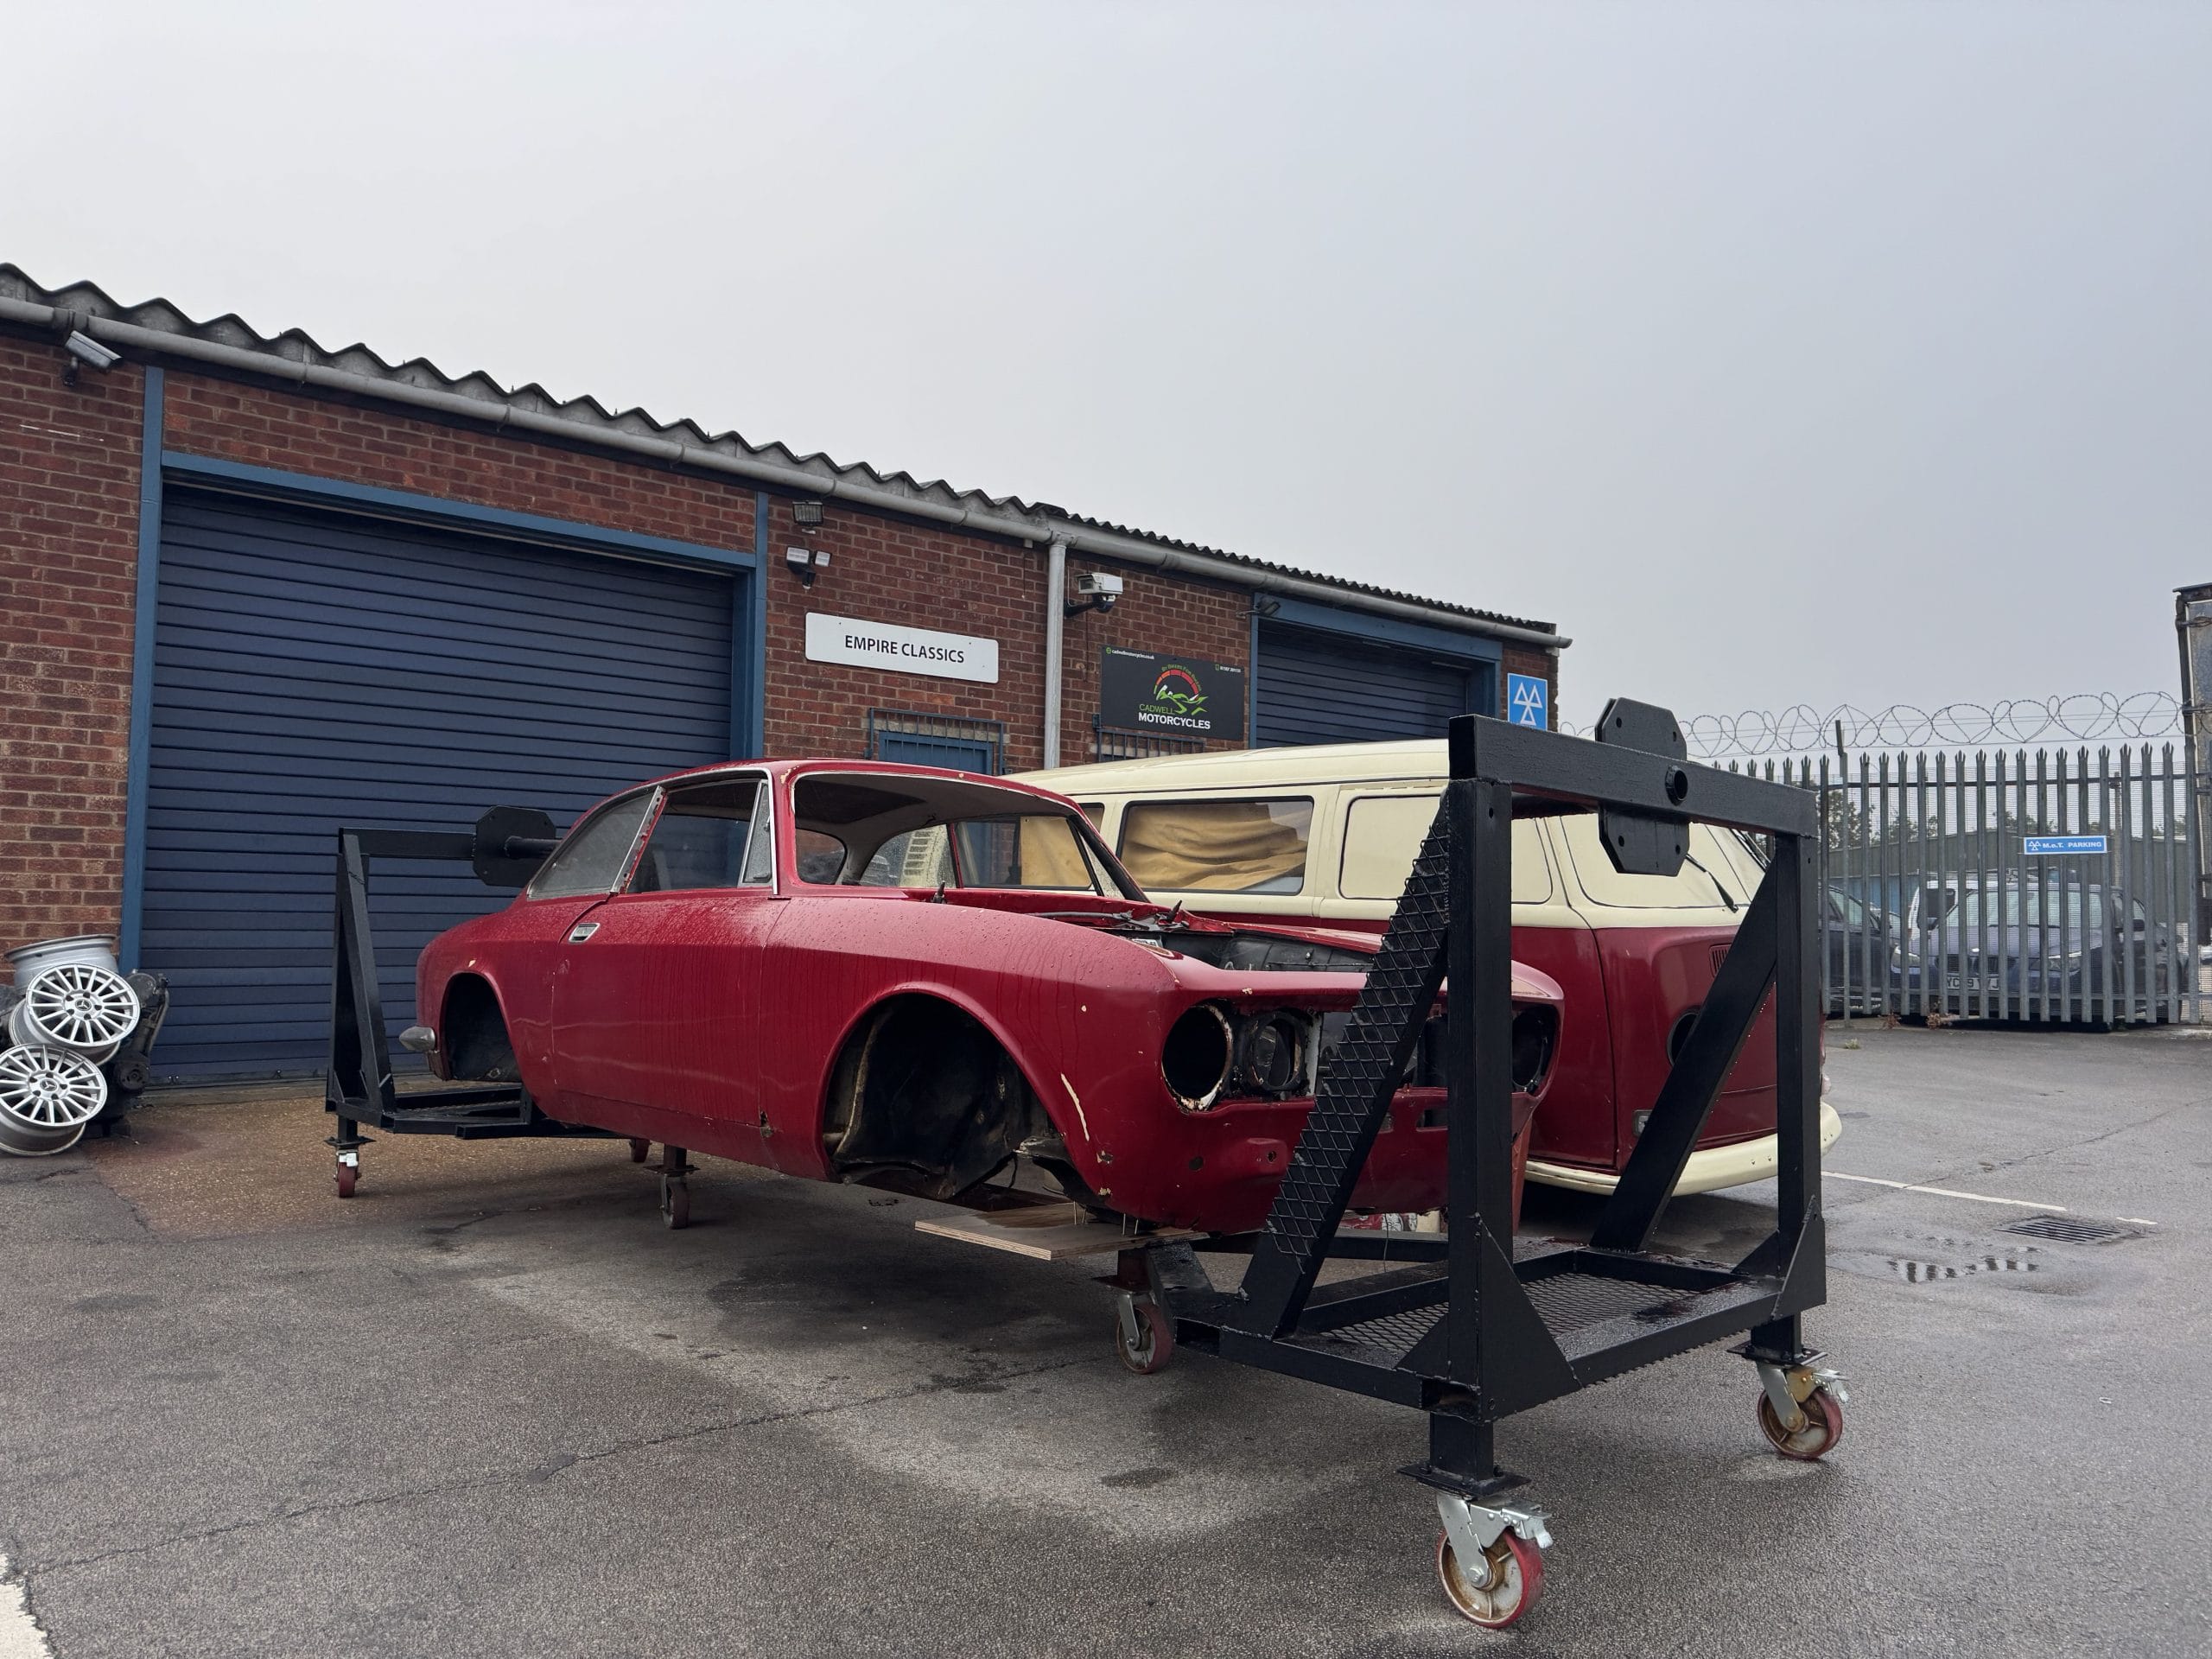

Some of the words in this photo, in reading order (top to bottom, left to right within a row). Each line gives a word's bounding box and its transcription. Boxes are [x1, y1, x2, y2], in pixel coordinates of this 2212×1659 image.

[845, 635, 898, 655] EMPIRE
[901, 643, 964, 664] CLASSICS
[1139, 703, 1175, 715] CADWELL
[1138, 712, 1211, 730] MOTORCYCLES
[1947, 977, 1974, 988] YC9
